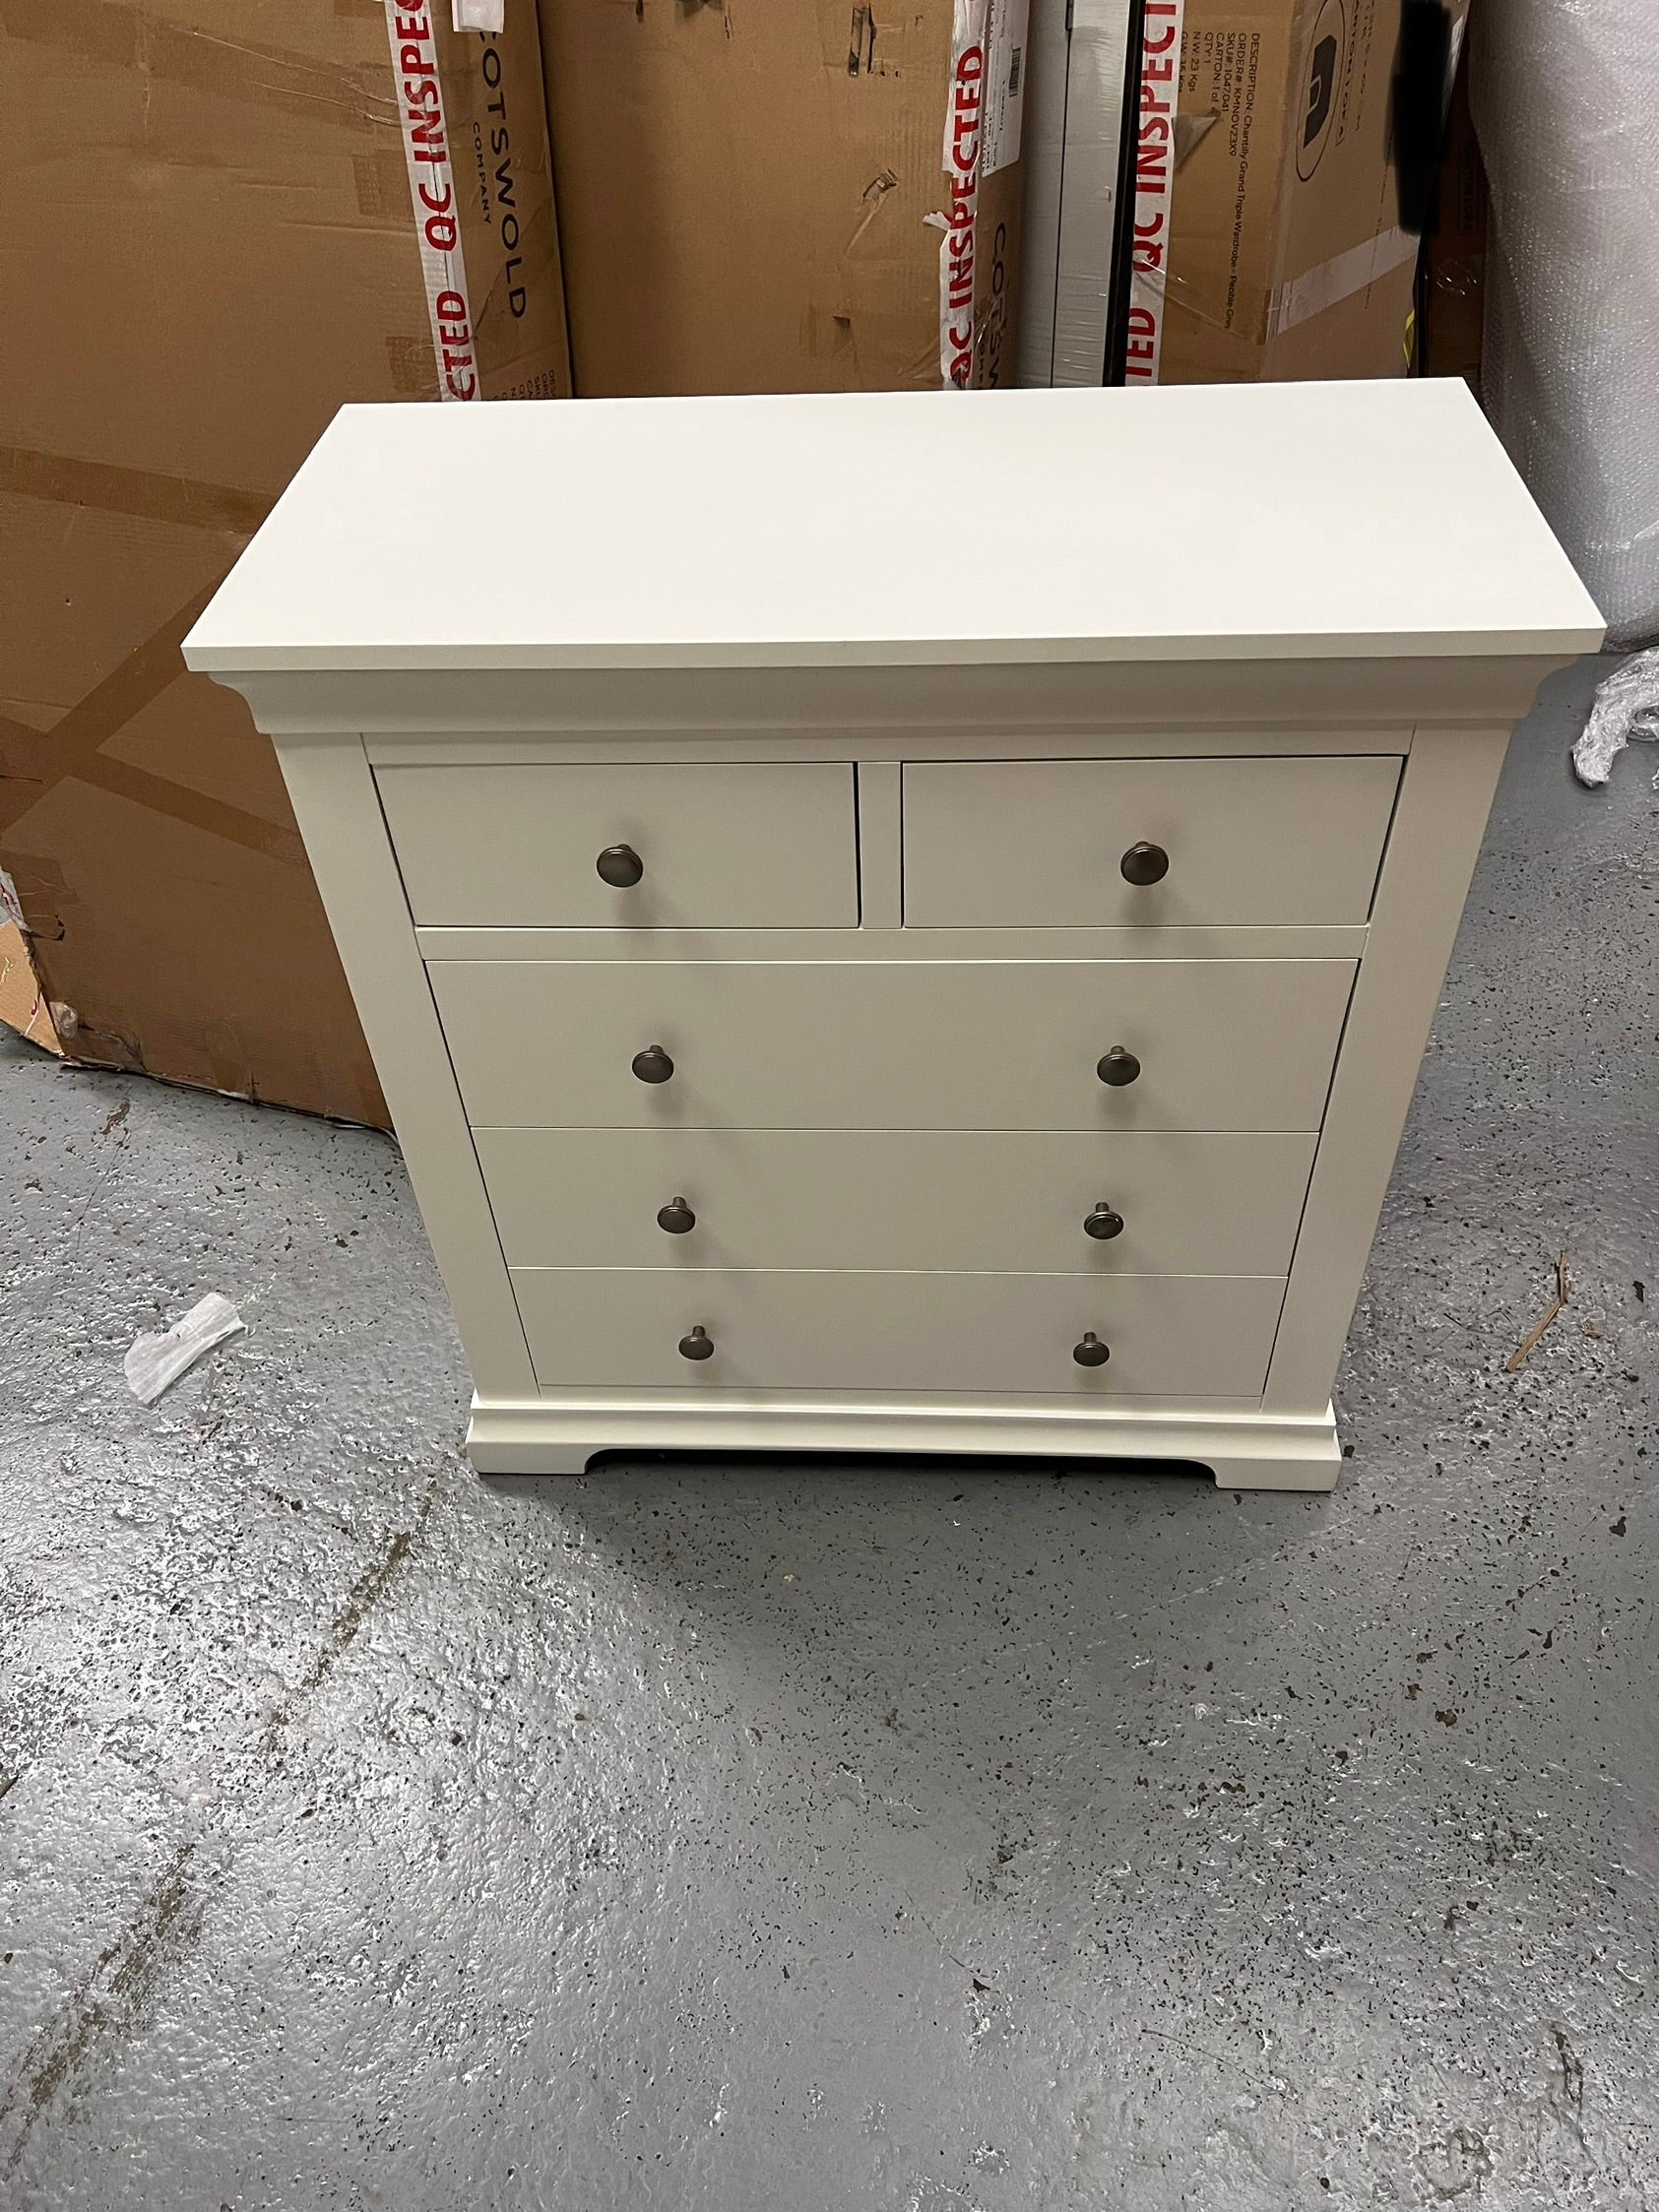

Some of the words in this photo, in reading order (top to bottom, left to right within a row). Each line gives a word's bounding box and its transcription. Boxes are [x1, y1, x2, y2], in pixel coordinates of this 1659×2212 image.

[1187, 74, 1198, 93] Kgs
[1190, 58, 1200, 72] 23
[1211, 92, 1220, 102] of
[1239, 115, 1252, 159] Chantilly
[473, 121, 491, 224] COMPANY
[479, 32, 527, 318] OTSWOLD
[948, 45, 984, 309] INSPECTED
[1237, 160, 1248, 193] Grand
[418, 183, 457, 252] QC
[1235, 194, 1245, 220] Triple
[1133, 213, 1164, 272] QC
[1231, 221, 1243, 268] Wardrobe
